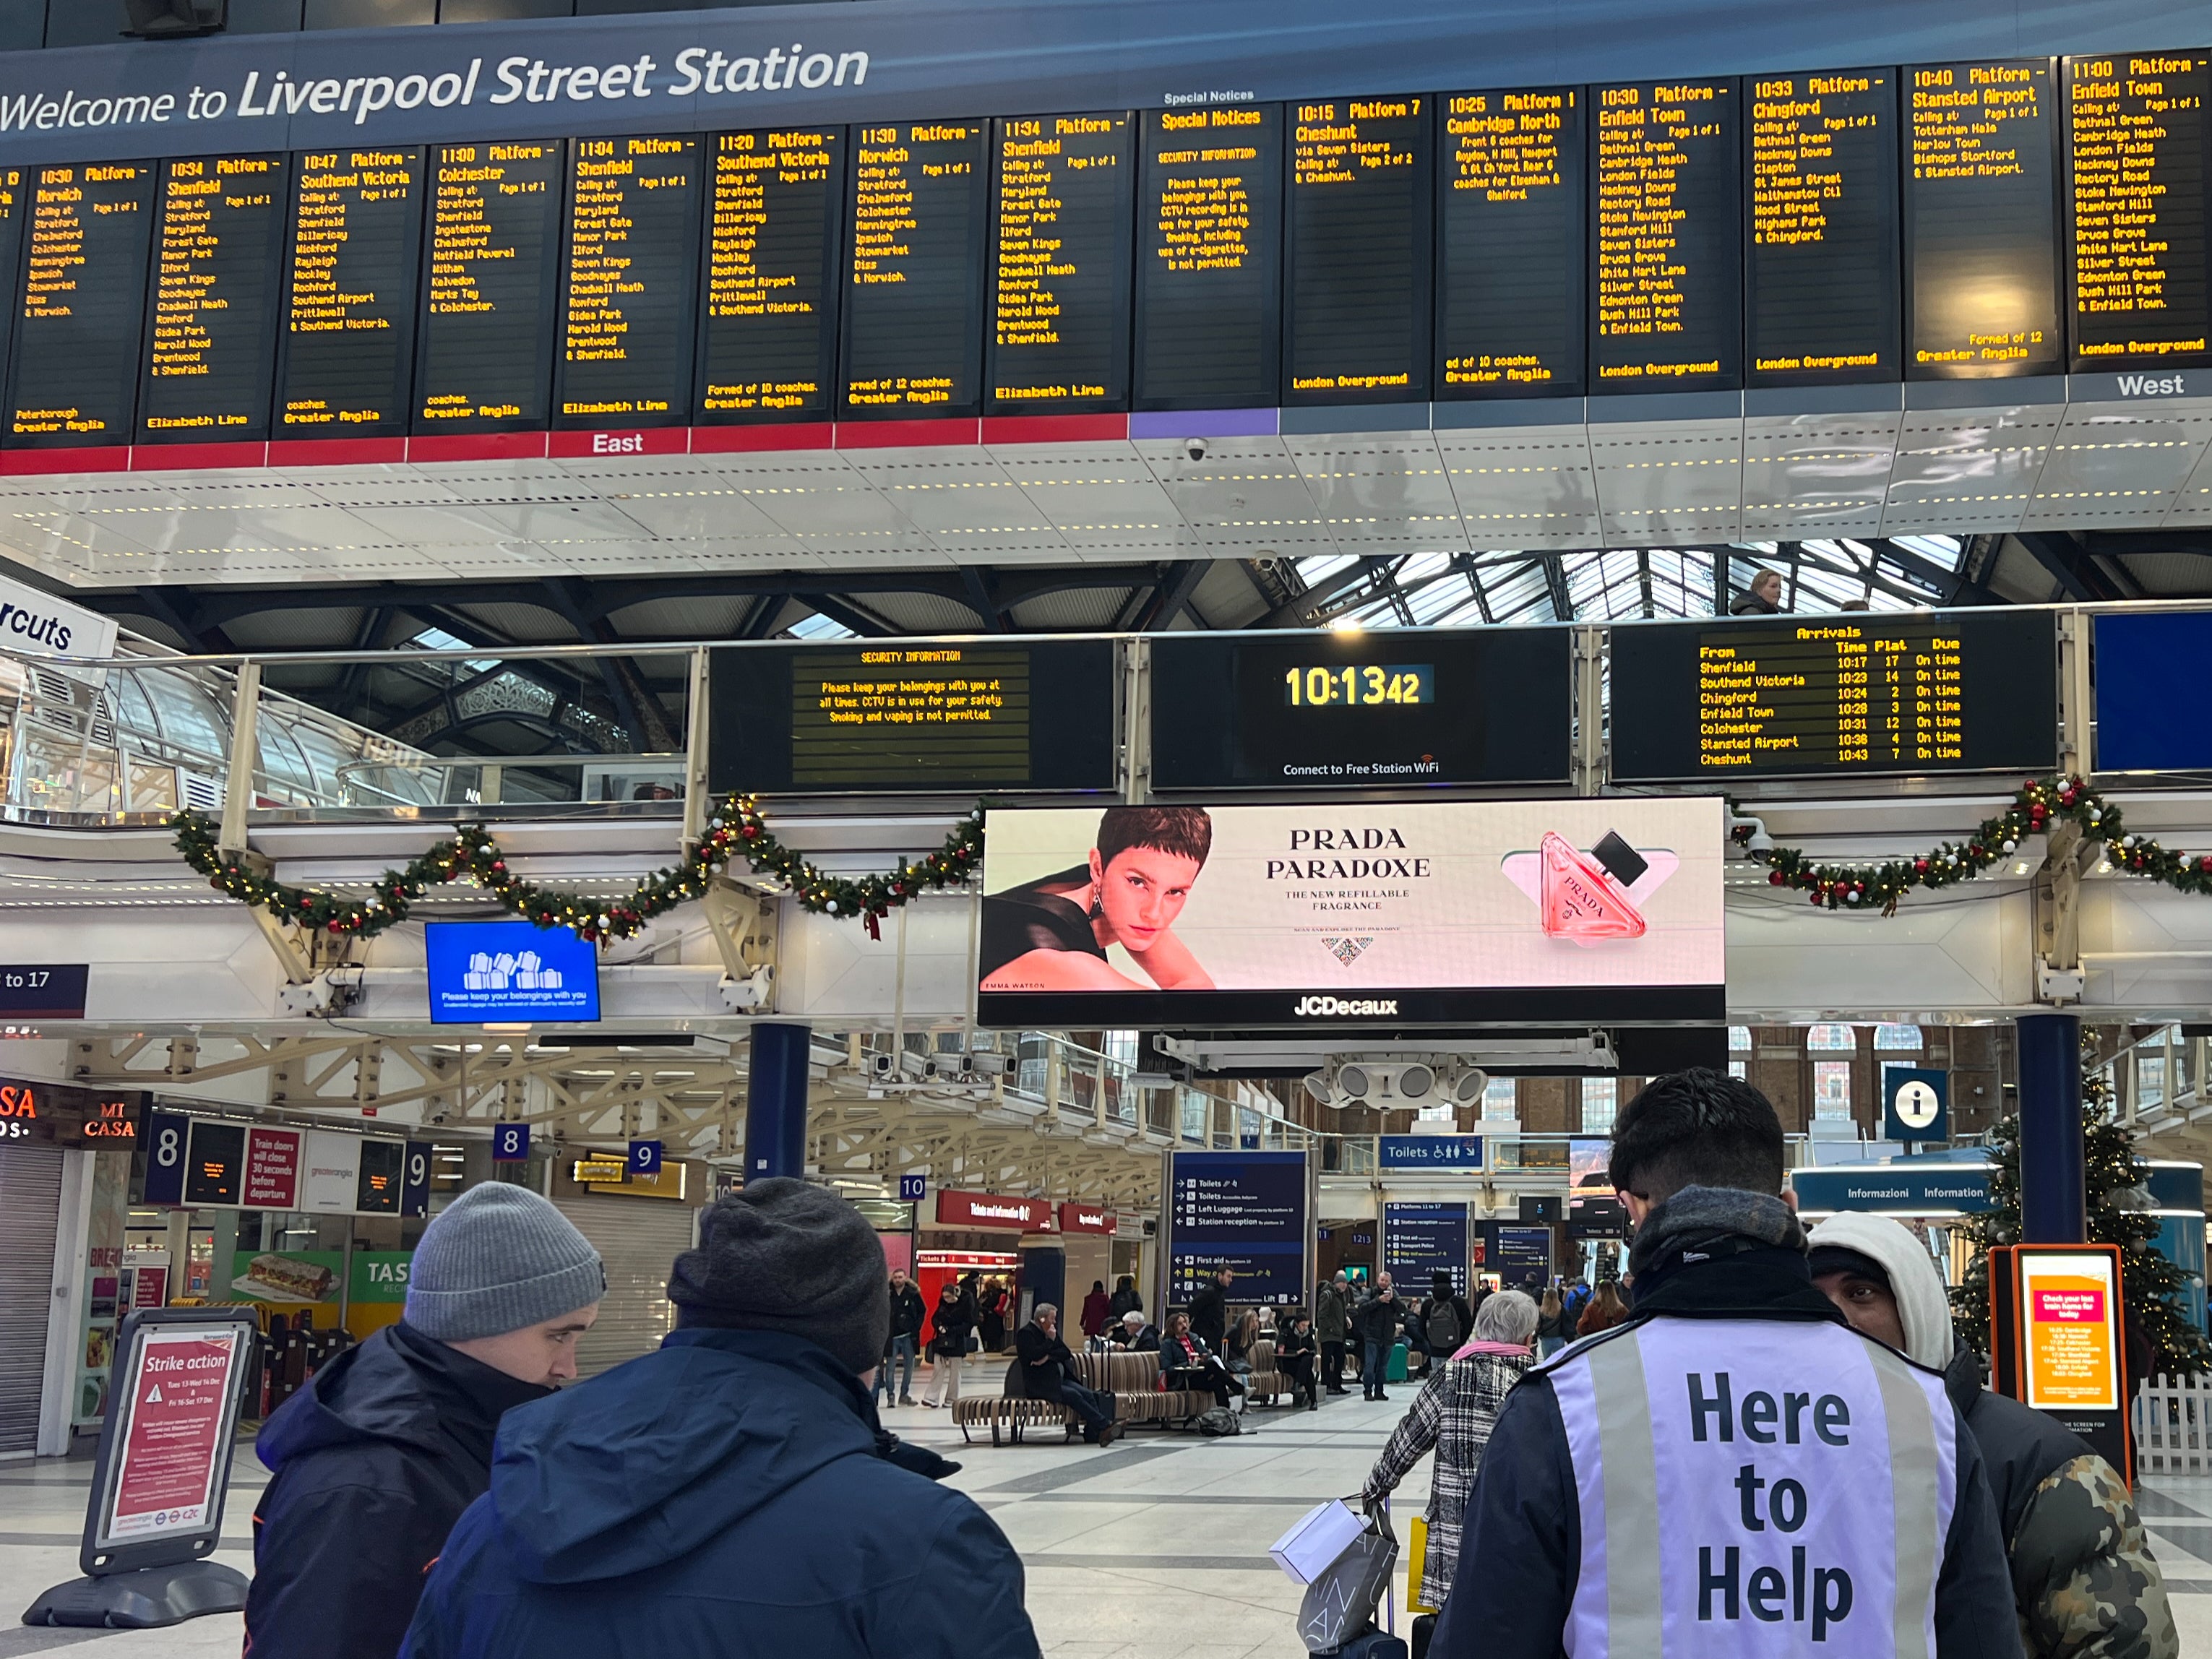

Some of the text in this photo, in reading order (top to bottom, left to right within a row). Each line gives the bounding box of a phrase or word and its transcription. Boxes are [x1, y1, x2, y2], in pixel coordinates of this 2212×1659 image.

[2074, 58, 2191, 78] 11:00 Platform
[1915, 67, 2030, 87] 10:40 Platform
[1, 44, 868, 131] Welcome to Liverpool Street Station
[1756, 77, 1868, 98] 10:33 Platform
[2073, 80, 2162, 99] Enfield Town
[1165, 90, 1254, 105] Special Notices
[1450, 92, 1575, 113] 10:25 Platform 1
[1913, 87, 2036, 108] Stansted Airport
[1299, 100, 1420, 121] 10:15 Platform 7
[1754, 99, 1820, 118] Chingford
[1006, 118, 1110, 137] 11:34 Platform
[1162, 110, 1260, 129] Special Notices
[1447, 113, 1560, 134] Cambridge North
[1296, 124, 1357, 142] Cheshunt
[442, 145, 541, 163] 11:00 Platform
[1003, 139, 1060, 156] Shenfield
[1296, 142, 1390, 156] via Seven Sisters
[1755, 147, 1832, 160] Hackney Downs
[305, 152, 403, 169] 10:47 Platform
[301, 171, 410, 189] Southend Victoria
[439, 166, 504, 182] Colchester
[1294, 373, 1408, 389] London Overground
[2117, 375, 2184, 395] West
[705, 395, 803, 408] Greater Anglia
[593, 434, 643, 452] East
[1797, 626, 1861, 639] Arrivals
[861, 651, 960, 663] SECURITY INFORMATION
[1700, 639, 1960, 658] From Time Plat Due
[1700, 654, 1960, 673] Shenfield 10:17 17 On time
[822, 680, 999, 694] Please keep your belongings with you at
[1700, 671, 1898, 689] Southend Victoria 10:23 14
[1700, 686, 1899, 705] Chingford 10:24 2
[1701, 702, 1899, 719] Enfield Town 10:28 3
[1701, 717, 1899, 734] Colchester 10:31 12
[1701, 738, 1750, 750] Stansted
[1755, 736, 1799, 750] Airport
[1892, 733, 1899, 744] 4
[1701, 748, 1899, 764] Cheshunt 10:43 7
[1284, 762, 1438, 775] Connect to Free Station WiFi
[1291, 829, 1406, 850] PRADA
[1268, 859, 1429, 879] PARADOXE
[1310, 890, 1334, 899] NEW
[1338, 889, 1410, 898] REFILLABLE
[1562, 874, 1606, 919] PRADA
[1312, 902, 1379, 910] FRAGRANCE
[6, 972, 49, 987] to 17
[442, 991, 587, 1002] Please keep your belongings with you
[1294, 996, 1397, 1015] JCDecaux
[101, 1103, 124, 1119] MI
[85, 1121, 134, 1137] CASA
[158, 1129, 178, 1166] 8
[255, 1138, 293, 1151] Train doors
[504, 1131, 517, 1152] 8
[253, 1150, 286, 1163] will close
[638, 1147, 651, 1166] 9
[1388, 1147, 1427, 1157] Toilets
[253, 1163, 293, 1176] 30 seconds
[410, 1154, 425, 1186] 9
[251, 1175, 275, 1186] before
[904, 1179, 923, 1194] 10
[250, 1188, 285, 1199] departure
[1848, 1187, 1984, 1198] Informazioni Information
[1198, 1205, 1243, 1215] Left Luggage
[1224, 1218, 1257, 1227] reception
[1197, 1256, 1225, 1264] First aid
[146, 1354, 225, 1372] Strike action
[1687, 1372, 1850, 1446] Here
[1734, 1464, 1807, 1533] to
[1698, 1546, 1853, 1642] Help
